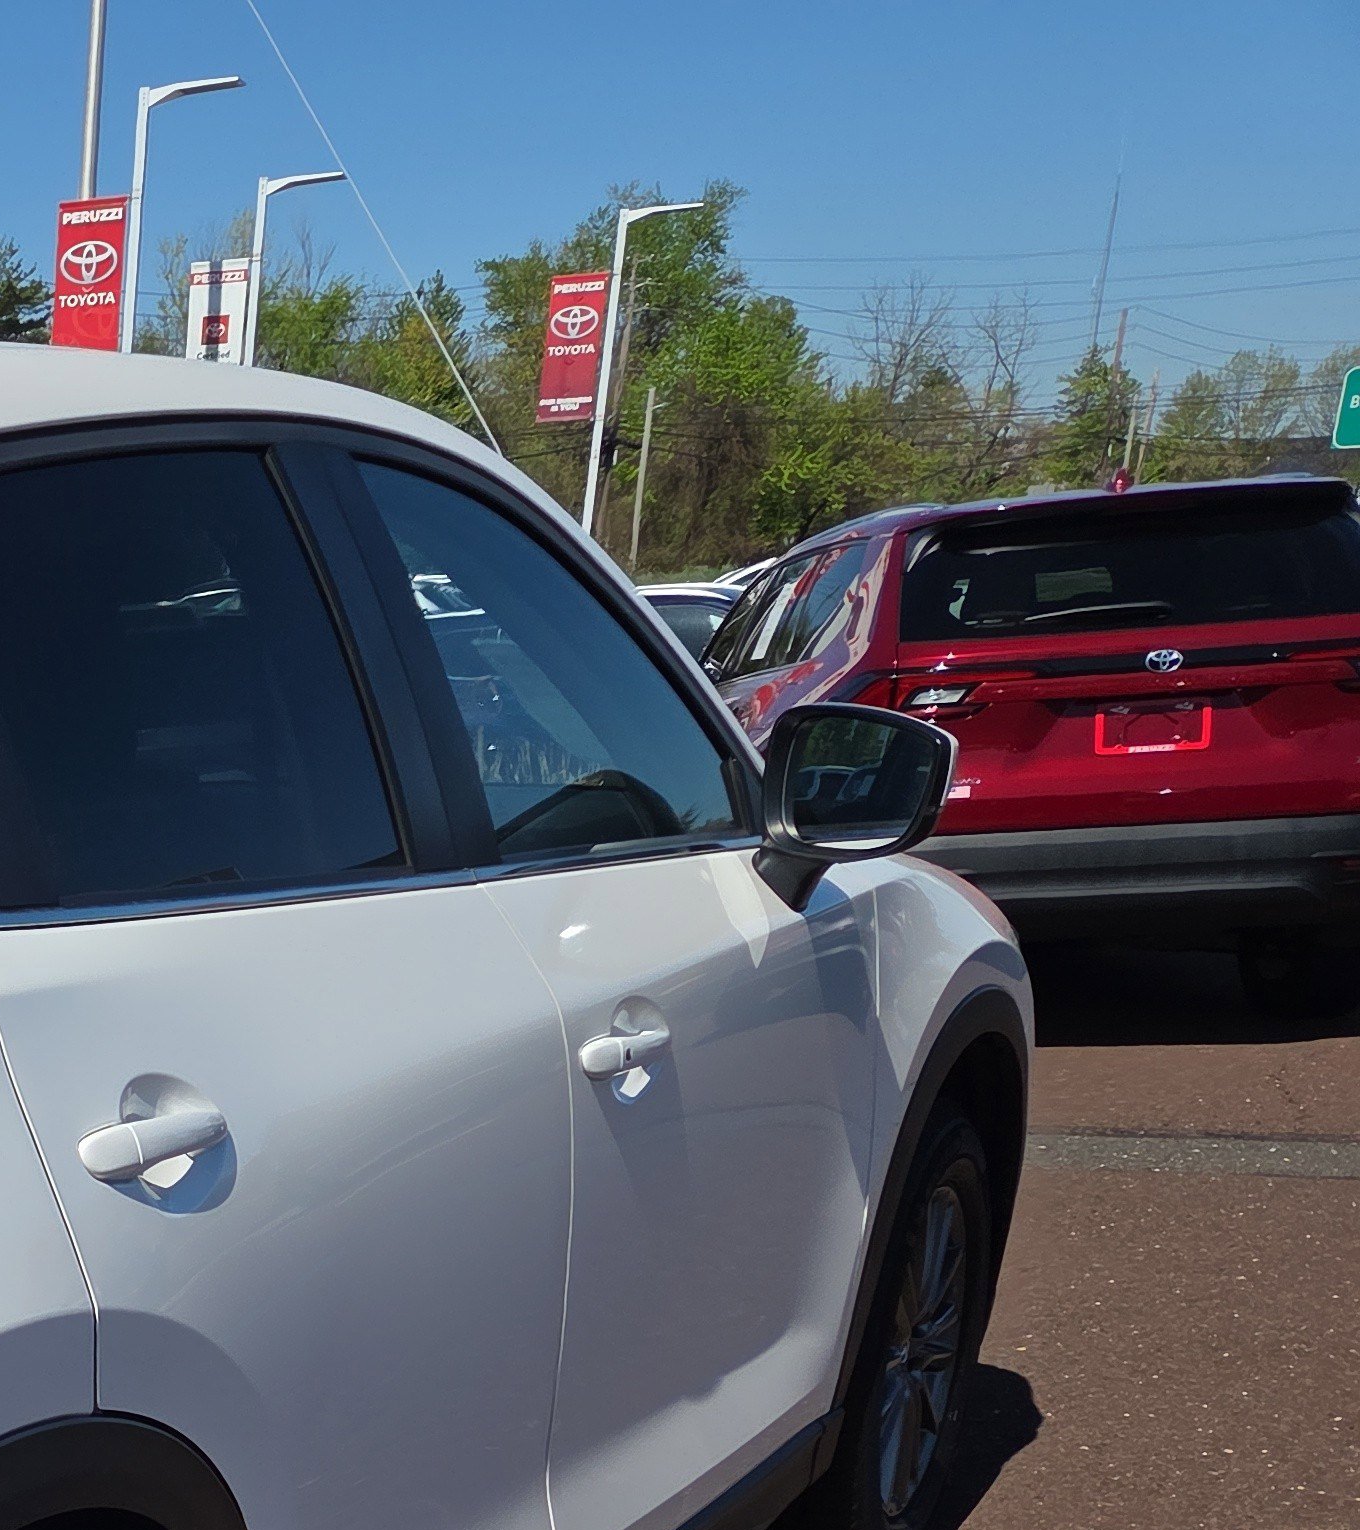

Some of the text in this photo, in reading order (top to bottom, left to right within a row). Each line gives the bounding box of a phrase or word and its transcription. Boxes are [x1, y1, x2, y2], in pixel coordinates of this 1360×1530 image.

[62, 207, 124, 225] PERUZZI
[59, 291, 116, 309] TOYOTA
[548, 343, 596, 357] TOYOTA
